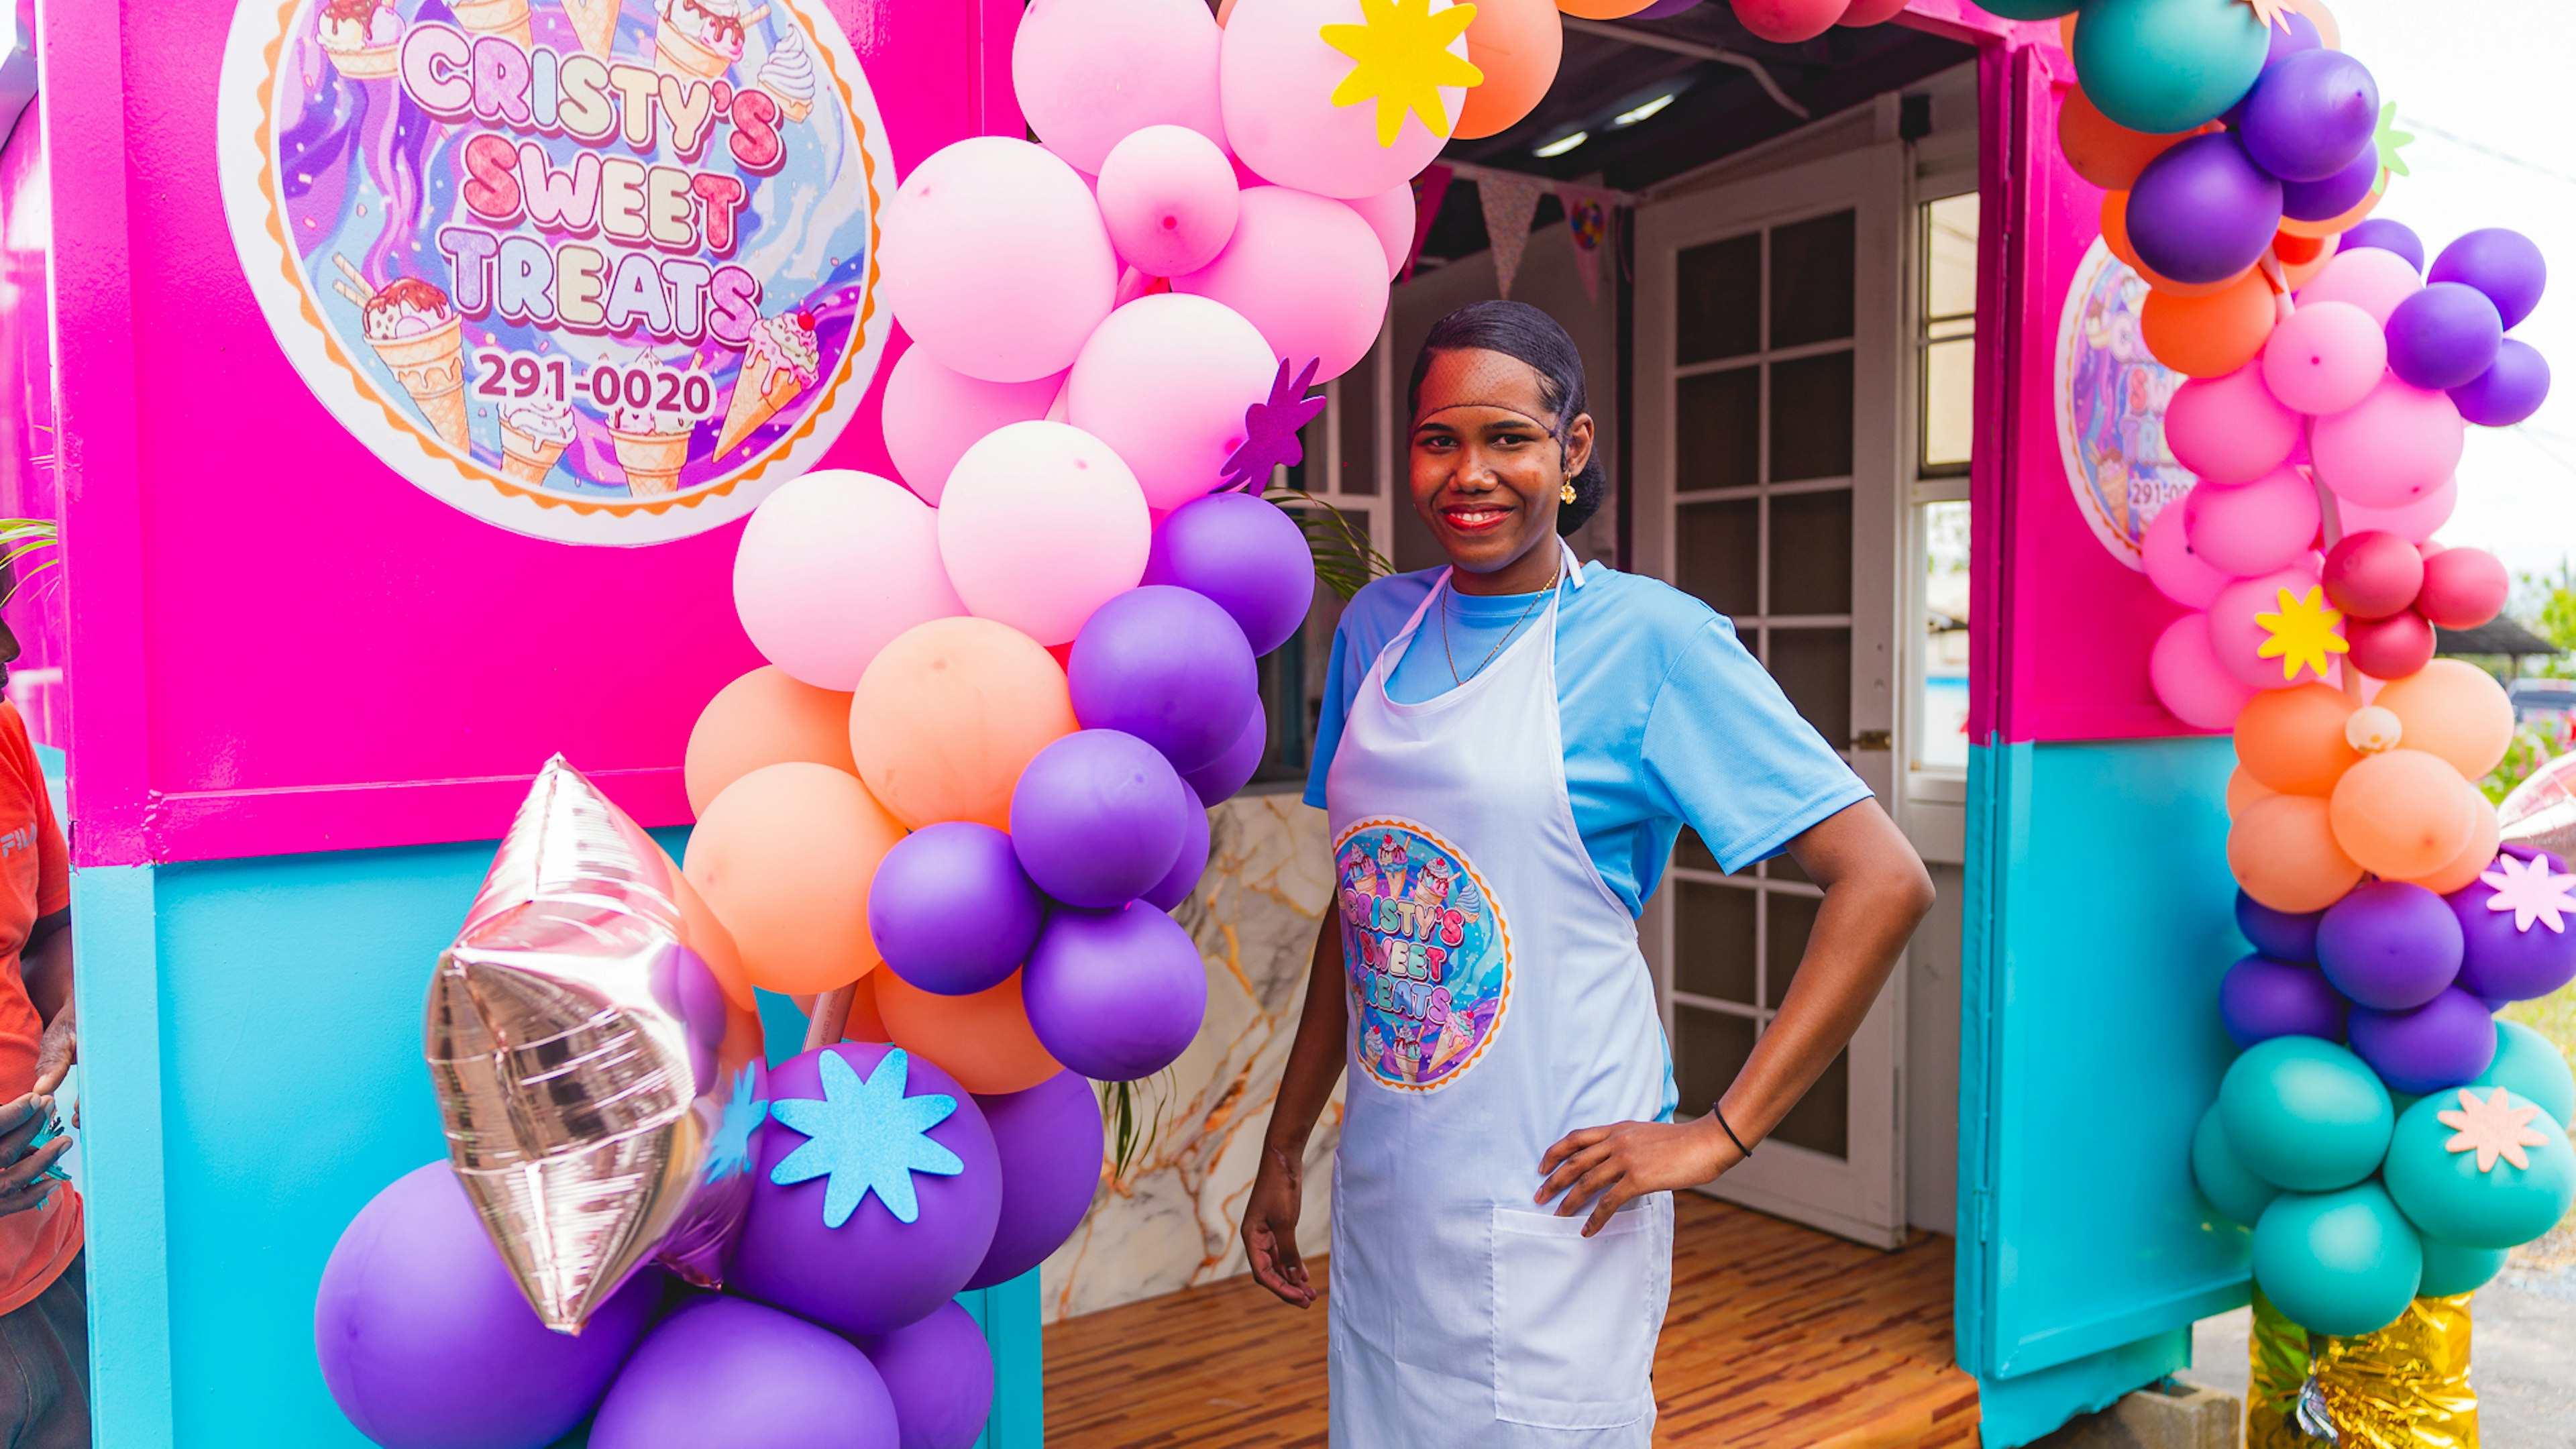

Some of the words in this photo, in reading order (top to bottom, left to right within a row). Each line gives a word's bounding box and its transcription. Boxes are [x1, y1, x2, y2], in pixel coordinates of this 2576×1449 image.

[402, 23, 785, 169] CRISTY'S
[462, 134, 743, 252] SWEET
[437, 226, 762, 346] TREATS
[477, 354, 711, 413] 291-0020
[2129, 368, 2184, 412] SW
[1346, 890, 1464, 945] CRISTY'S
[1360, 930, 1447, 981] SWEET
[1358, 965, 1452, 1023] TREATS
